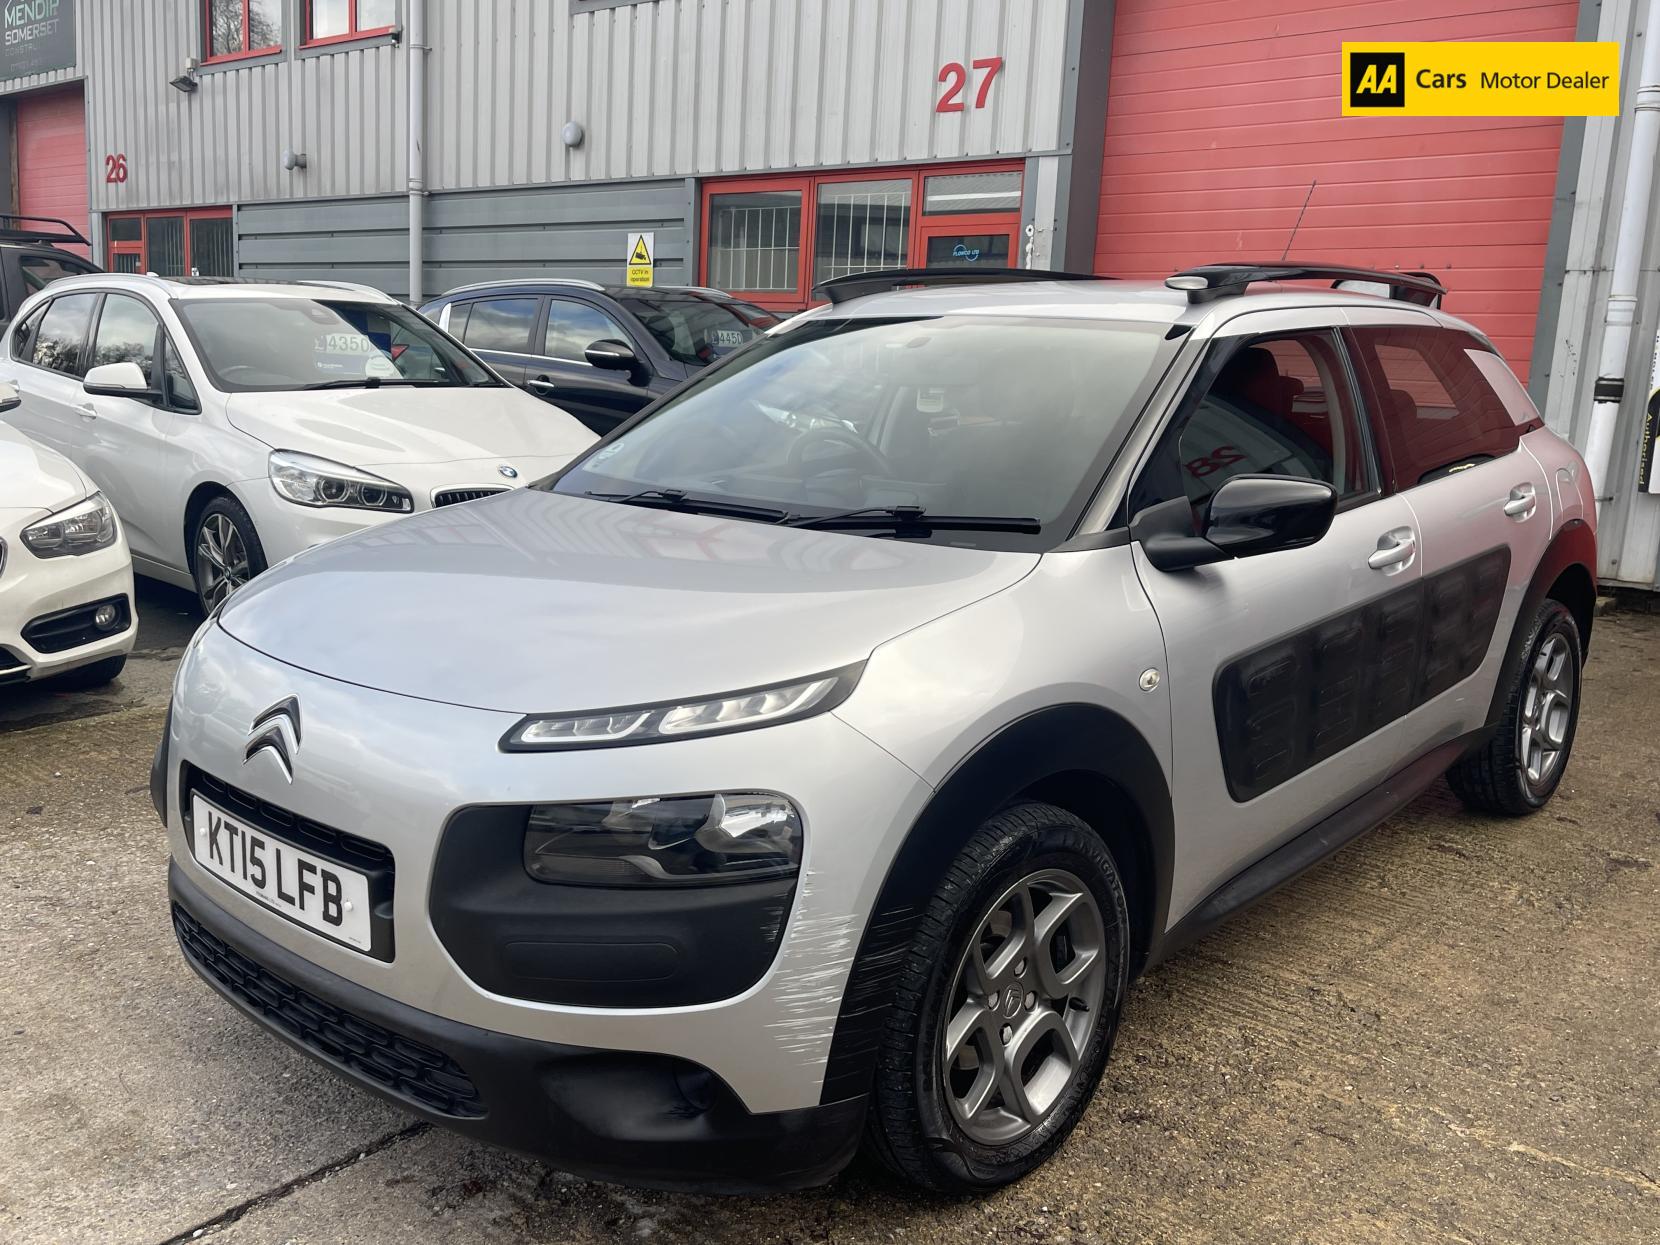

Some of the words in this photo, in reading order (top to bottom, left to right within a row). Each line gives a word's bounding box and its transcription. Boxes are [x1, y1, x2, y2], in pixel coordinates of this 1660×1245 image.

[4, 0, 60, 28] MENDIP
[5, 19, 59, 45] SOMERSET
[935, 56, 1003, 113] 27
[105, 153, 127, 183] 26
[208, 810, 266, 889] KT15
[276, 847, 343, 927] LFB
